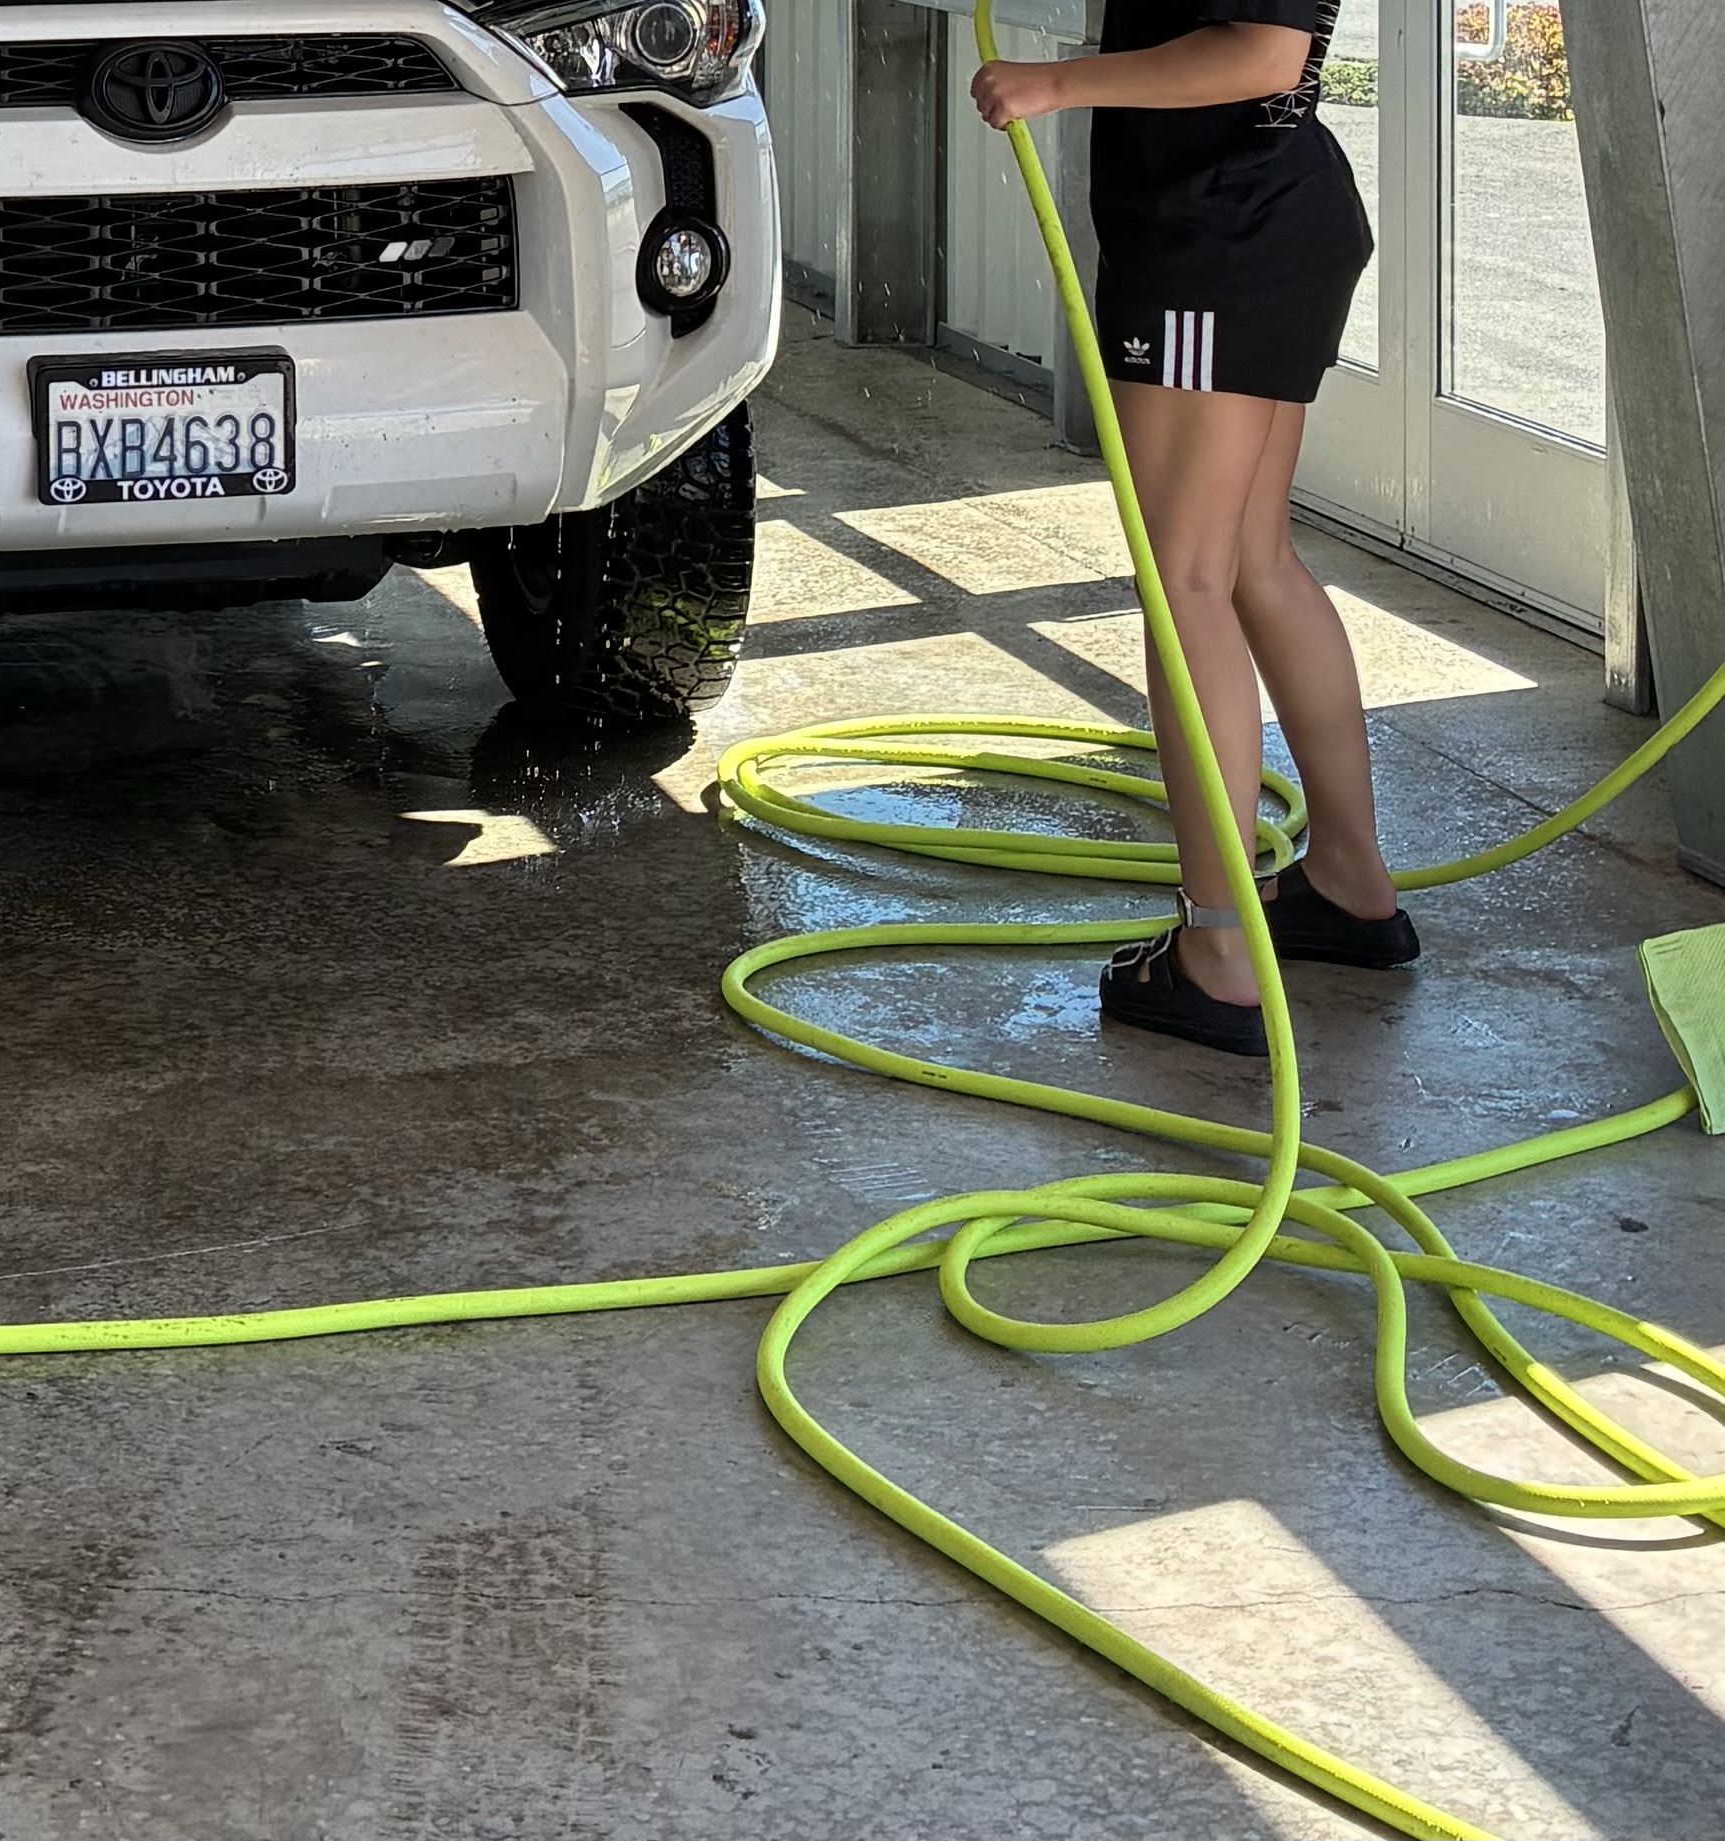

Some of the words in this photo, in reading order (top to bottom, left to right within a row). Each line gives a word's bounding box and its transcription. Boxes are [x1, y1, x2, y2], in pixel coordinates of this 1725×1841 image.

[101, 366, 235, 387] BELLINGHAM
[59, 389, 194, 410] WASHINGTON
[57, 413, 275, 479] BXB4638
[117, 477, 225, 500] TOYOTA
